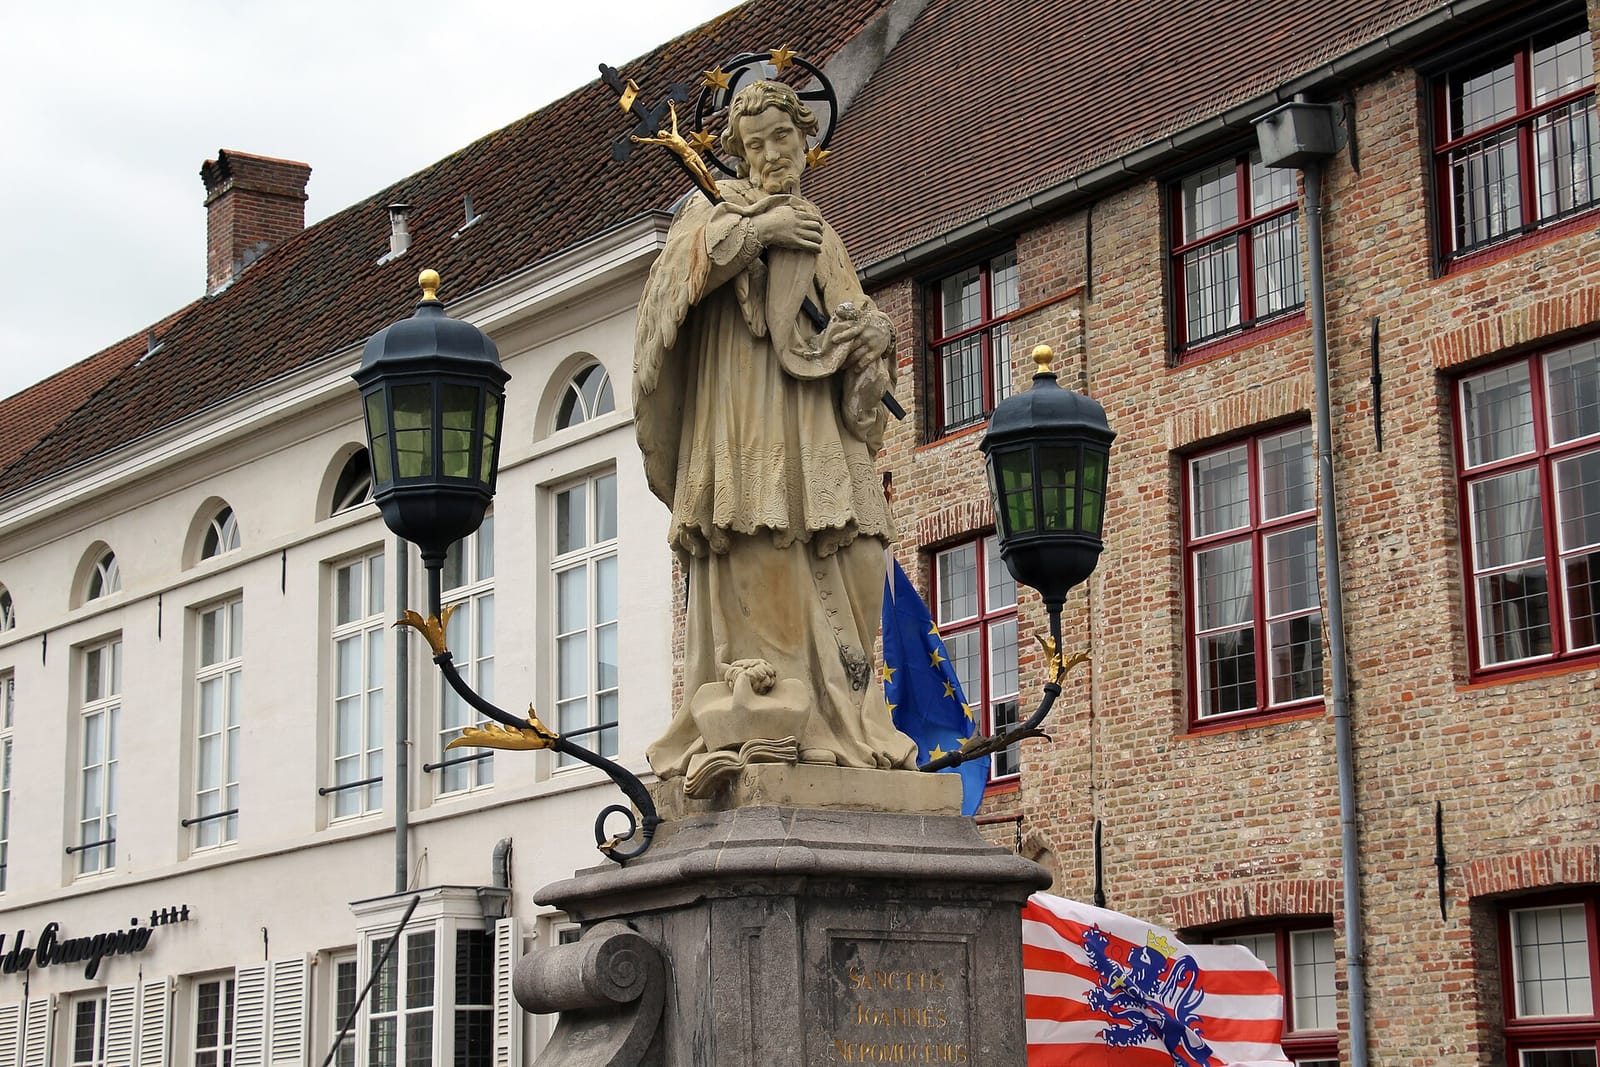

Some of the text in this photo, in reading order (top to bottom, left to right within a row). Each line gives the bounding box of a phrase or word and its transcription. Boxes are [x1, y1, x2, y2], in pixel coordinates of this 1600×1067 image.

[36, 917, 153, 980] Orangerie
[849, 966, 945, 992] SANCTUS
[833, 1039, 968, 1064] NEPOMUCENUS
